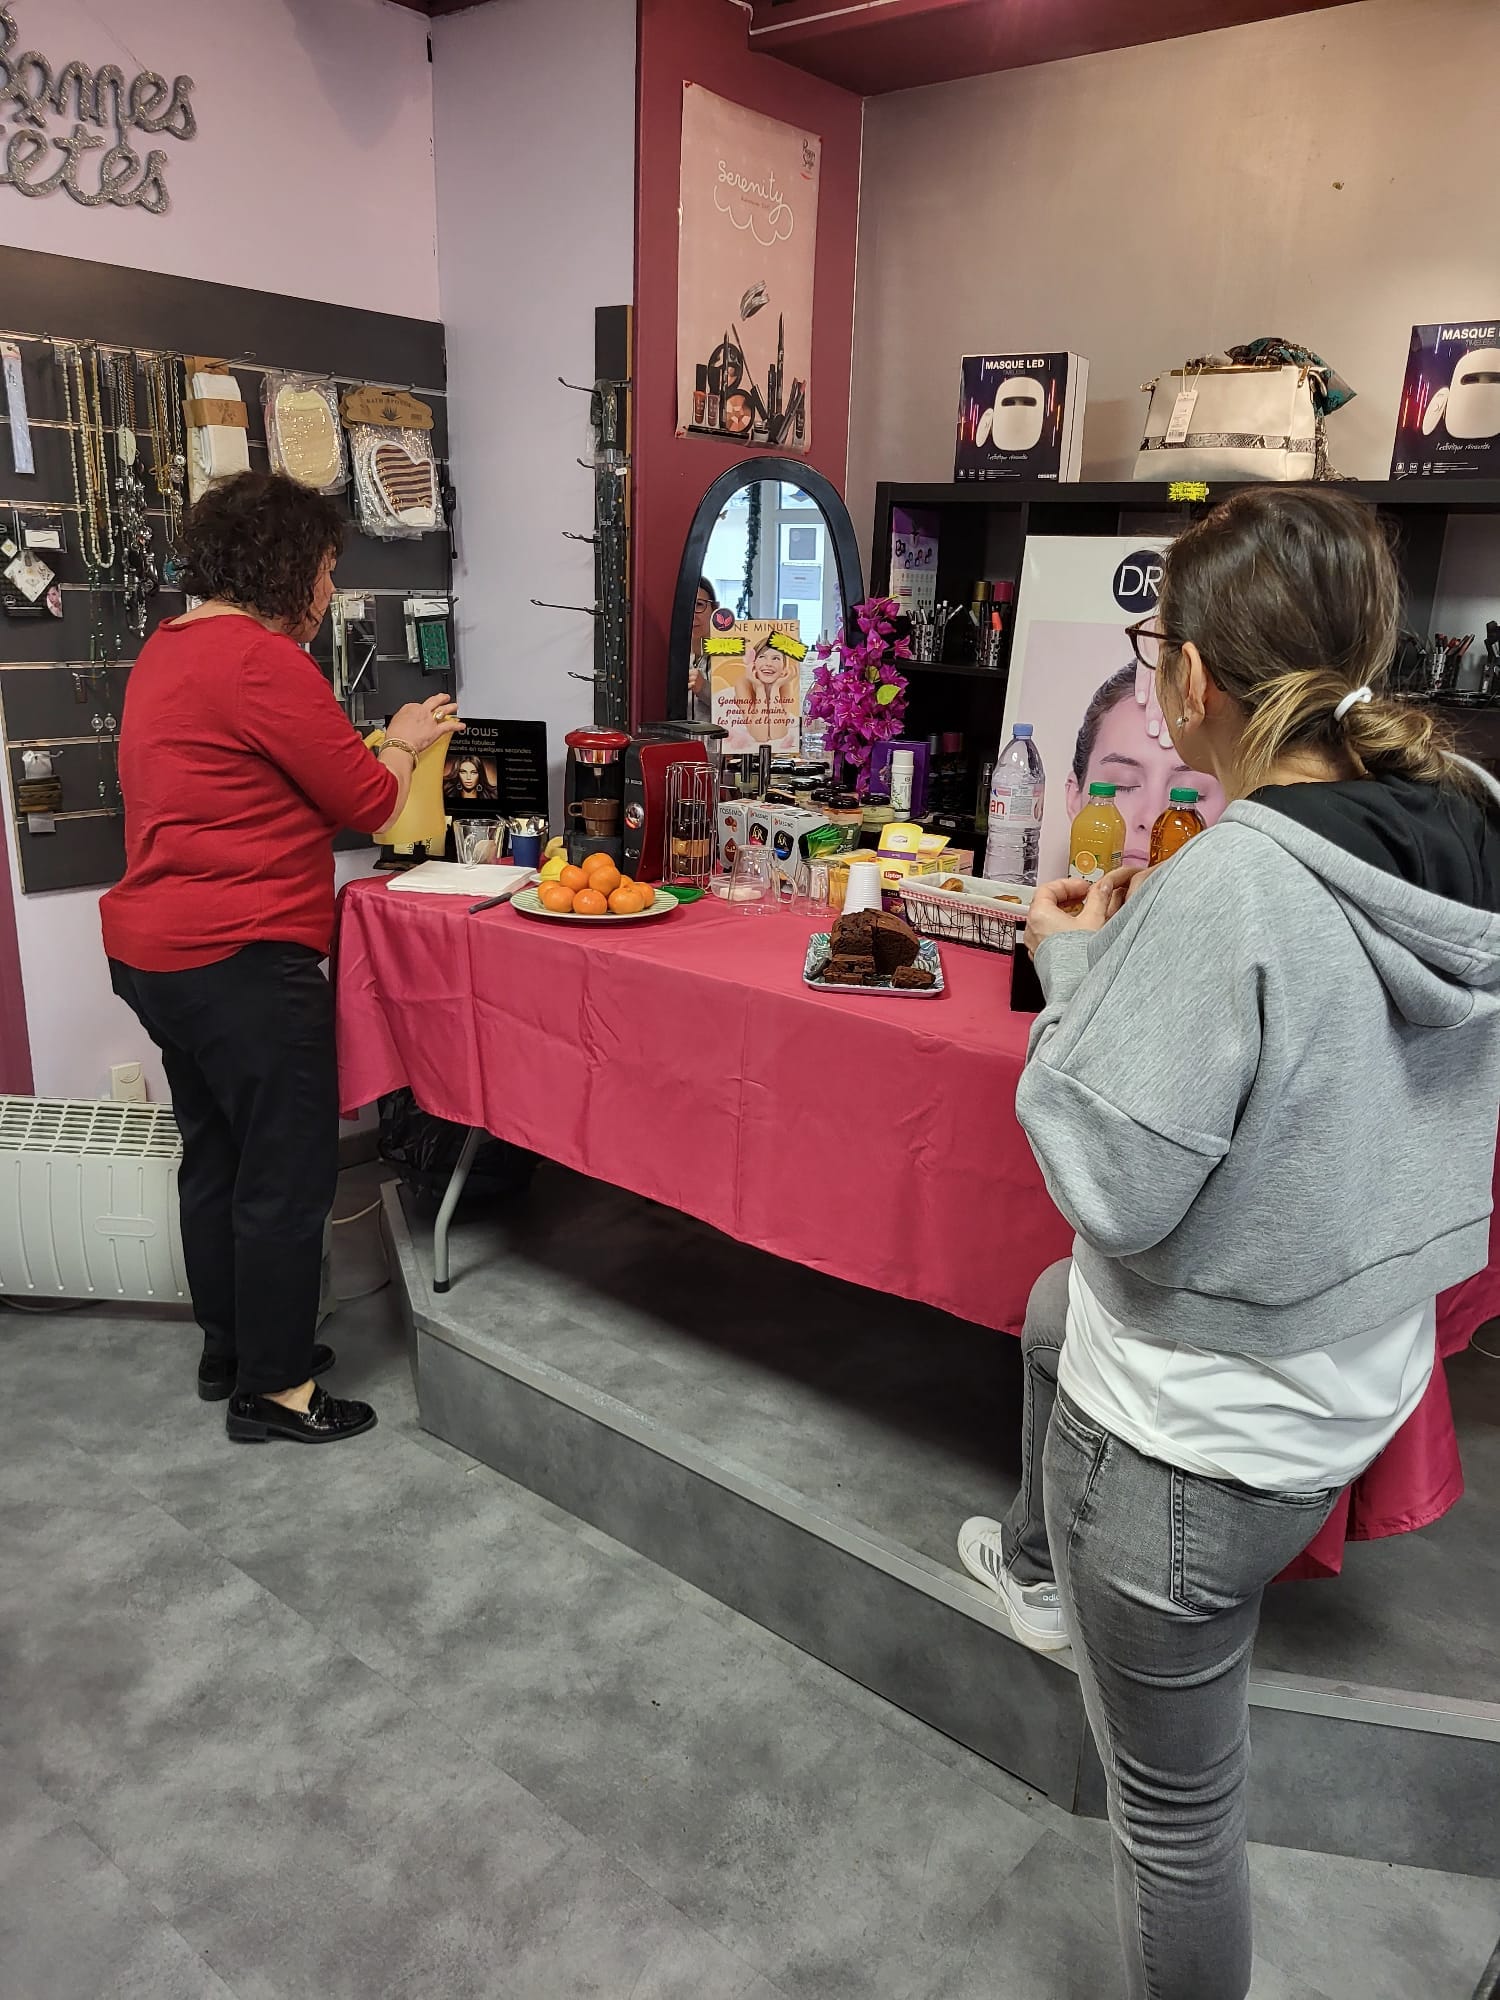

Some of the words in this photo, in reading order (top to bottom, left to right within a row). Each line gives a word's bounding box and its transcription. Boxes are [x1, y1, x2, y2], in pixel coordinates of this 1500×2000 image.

[718, 160, 784, 225] Serenity
[1441, 327, 1497, 341] MASQUE
[985, 360, 1024, 370] MASQUE
[1026, 359, 1045, 369] LED
[1118, 565, 1164, 597] DR
[718, 695, 762, 706] Gommages
[773, 695, 795, 705] Soins
[725, 706, 746, 716] pour
[747, 705, 759, 715] les
[717, 716, 729, 726] les
[731, 716, 753, 727] pieds
[773, 717, 795, 727] corps
